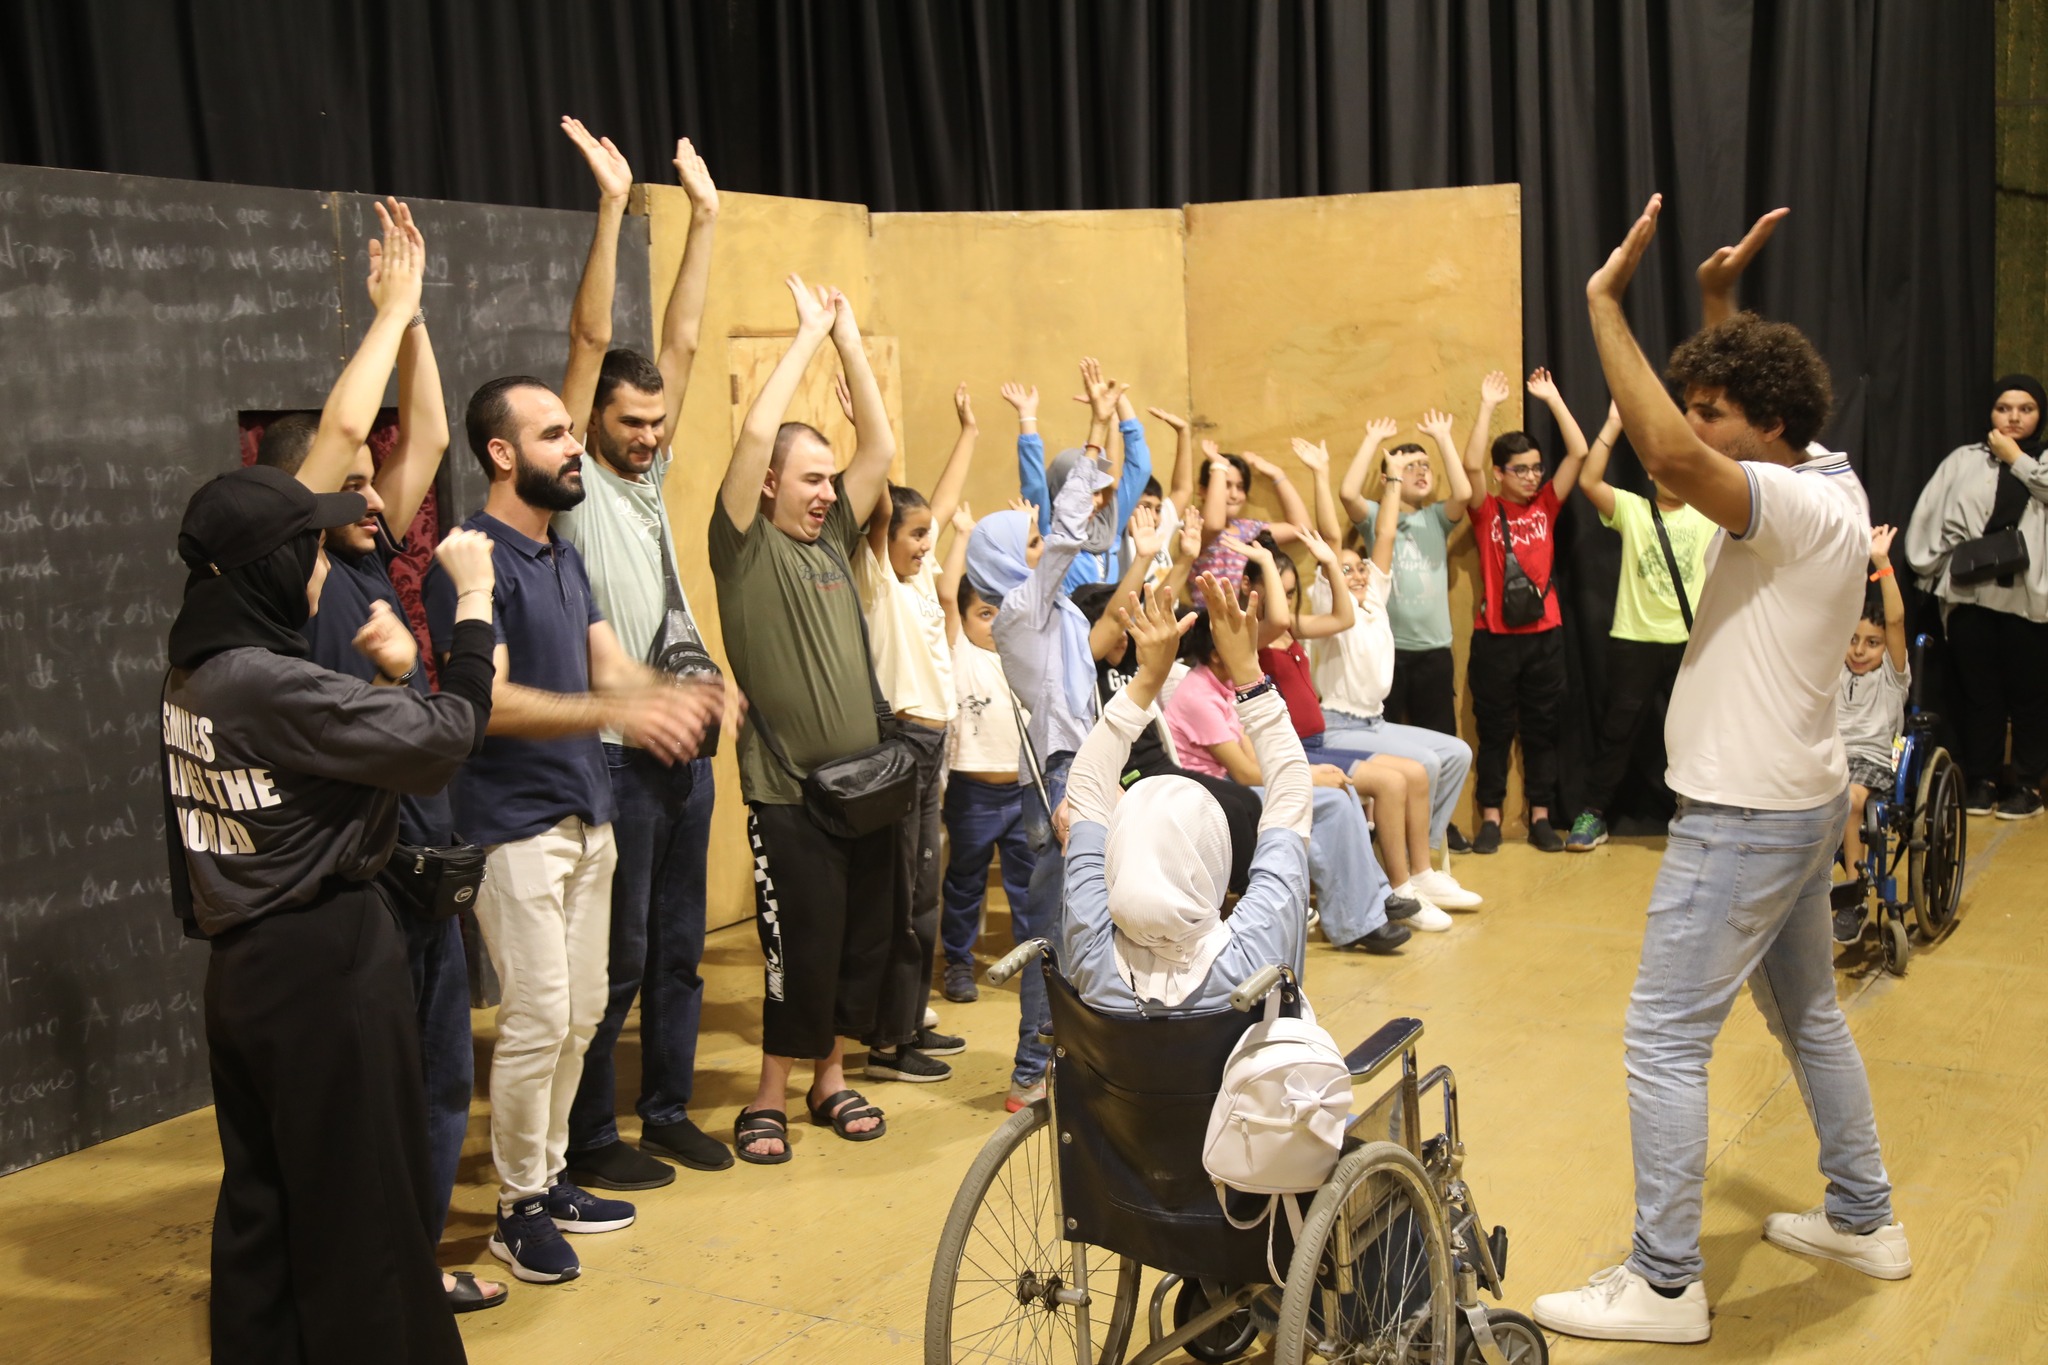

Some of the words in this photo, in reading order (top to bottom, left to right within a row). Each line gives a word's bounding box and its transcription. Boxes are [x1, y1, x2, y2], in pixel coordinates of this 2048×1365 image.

[163, 701, 215, 763] SMILES
[205, 768, 282, 812] THE
[525, 1201, 541, 1212] NIKE
